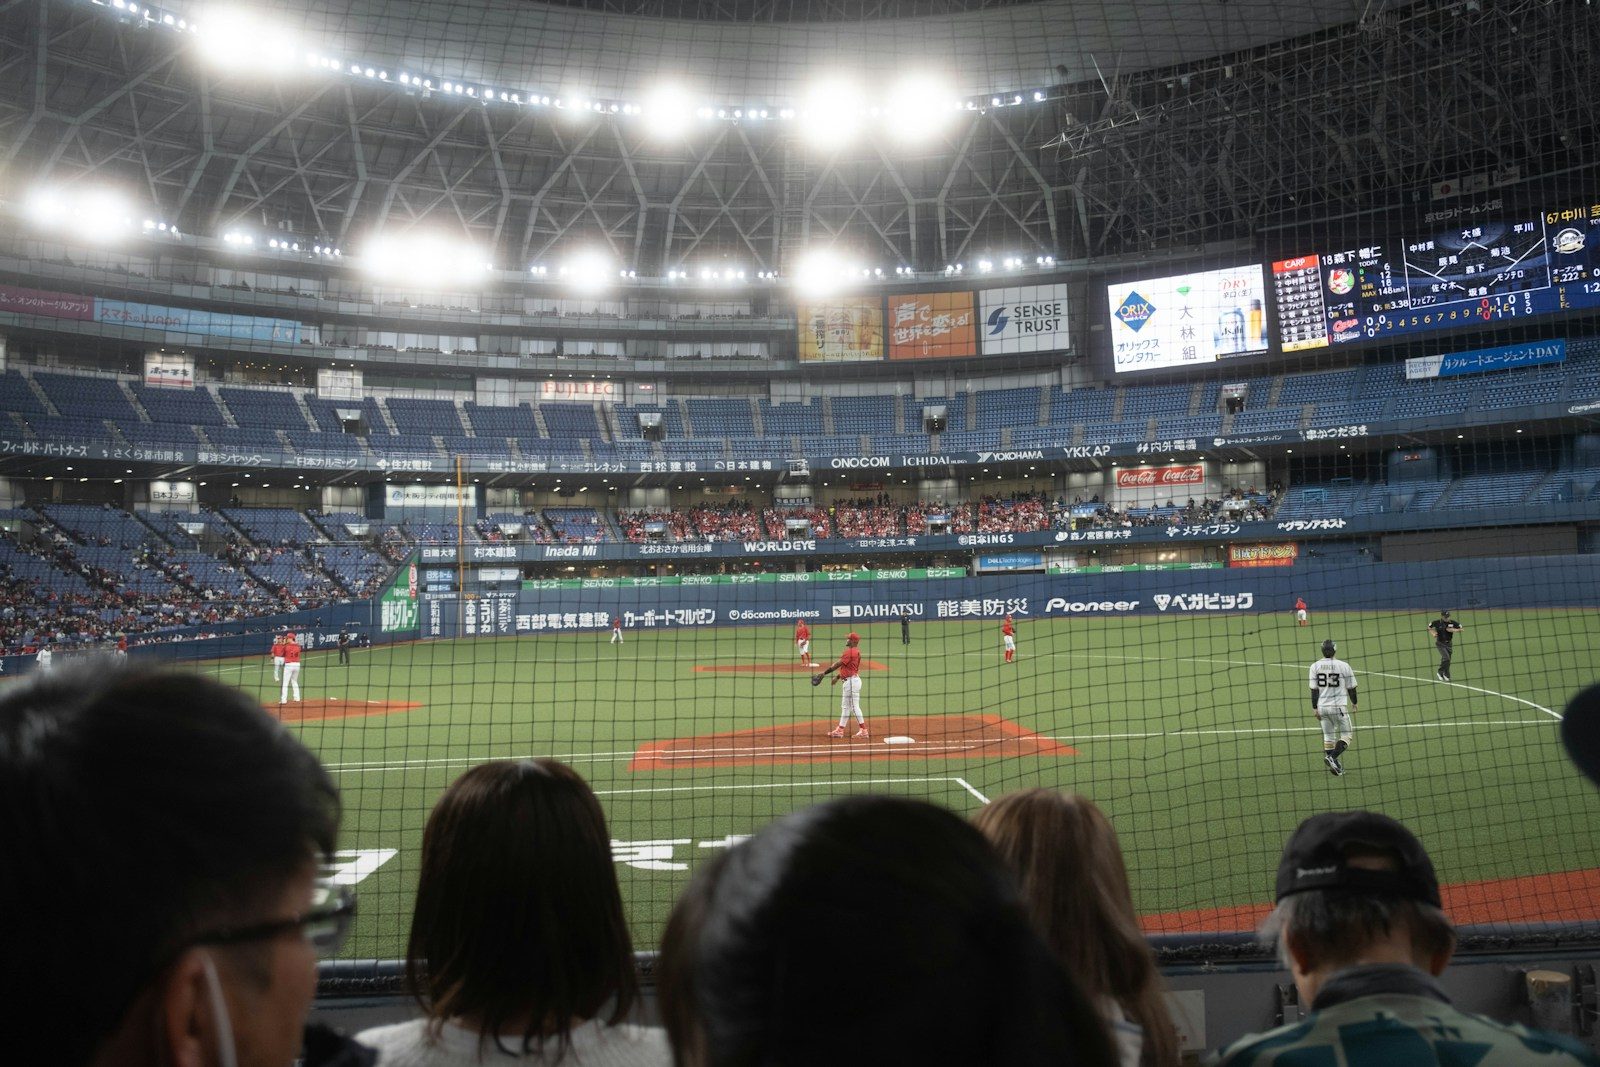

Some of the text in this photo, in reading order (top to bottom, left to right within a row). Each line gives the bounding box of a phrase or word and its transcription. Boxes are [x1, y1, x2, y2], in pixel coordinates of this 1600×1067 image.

[1425, 199, 1503, 223] 京セラドーム 大阪
[1546, 207, 1587, 225] 67 中川
[1462, 227, 1482, 239] 大盛
[1514, 222, 1534, 234] 平川
[1322, 255, 1333, 265] 18
[1333, 250, 1355, 264] 森下
[1490, 246, 1510, 257] 菊池
[1284, 258, 1305, 268] CARP
[1358, 259, 1378, 267] TODAY
[1384, 262, 1390, 270] 6
[1438, 255, 1458, 266] 辰見
[1465, 263, 1485, 274] 森下
[1553, 265, 1583, 275] オープン戦
[1380, 271, 1391, 279] 12
[1497, 270, 1524, 281] モンテロ
[1222, 280, 1247, 290] DRY
[1381, 278, 1392, 287] 18
[1431, 281, 1456, 293] 佐々木
[1468, 286, 1487, 297] 坂倉
[1525, 292, 1530, 300] B
[1014, 303, 1061, 318] SENSE
[1119, 303, 1150, 316] ORIX
[1327, 302, 1353, 311] オープン戦
[1366, 295, 1515, 326] 0 0 0 1 0
[894, 301, 931, 327] 声で
[1375, 323, 1380, 331] 2
[1387, 321, 1393, 329] 3
[1399, 319, 1405, 327] 4
[1412, 317, 1418, 325] 5
[1424, 315, 1431, 323] 6
[1437, 313, 1443, 321] 7
[1450, 311, 1456, 319] 8
[1463, 309, 1470, 317] 9
[1489, 305, 1496, 313] H
[1503, 303, 1509, 311] E
[1015, 318, 1060, 333] TRUST
[1368, 306, 1515, 337] 0 0 1 1
[1179, 305, 1196, 360] 大林組
[1117, 339, 1159, 352] オリックス
[1117, 352, 1161, 364] レンタカー
[1444, 345, 1560, 369] リクルートエージェントDAY
[544, 382, 614, 395] FUJITEC
[1306, 425, 1368, 440] 串かつだるま
[2, 440, 88, 457] フィールド・パートナーズ
[1064, 445, 1110, 458] YKK AP
[1151, 439, 1197, 452] 内外電機
[113, 448, 184, 461] さくら都市開発
[992, 450, 1043, 462] YOKOHAMA
[296, 457, 358, 468] 日本カルミック
[584, 462, 626, 473] テレネット
[641, 462, 696, 472] 西松建設
[727, 460, 771, 471] 日本建物
[831, 457, 890, 468] ONOCOM
[903, 456, 949, 467] ICHIDAI
[1120, 468, 1200, 484] Coca-Cola Coca-Cola
[153, 491, 193, 500] 日本ステージ
[1182, 524, 1240, 536] メディプラン
[1285, 519, 1346, 531] グランアネスト
[968, 534, 1013, 545] 日本INGS
[1070, 530, 1132, 541] 森ノ宮医療大学
[474, 547, 516, 557] 村本建設
[545, 545, 597, 557] Inada Mi
[640, 544, 712, 554] 北おおさか信用金庫
[533, 569, 956, 589] センコー SENKO センコー SENKO センコー SENKO センコー SENKO センコー
[853, 603, 923, 617] DAIHATSU
[937, 598, 1028, 617] 能美防災
[1045, 598, 1139, 613] Pioneer
[480, 599, 491, 633] エコリカ
[623, 609, 716, 628] カーポートマルゼン
[741, 609, 820, 619] docomo Business
[516, 612, 609, 630] 西部電気建設
[1316, 673, 1340, 687] 83
